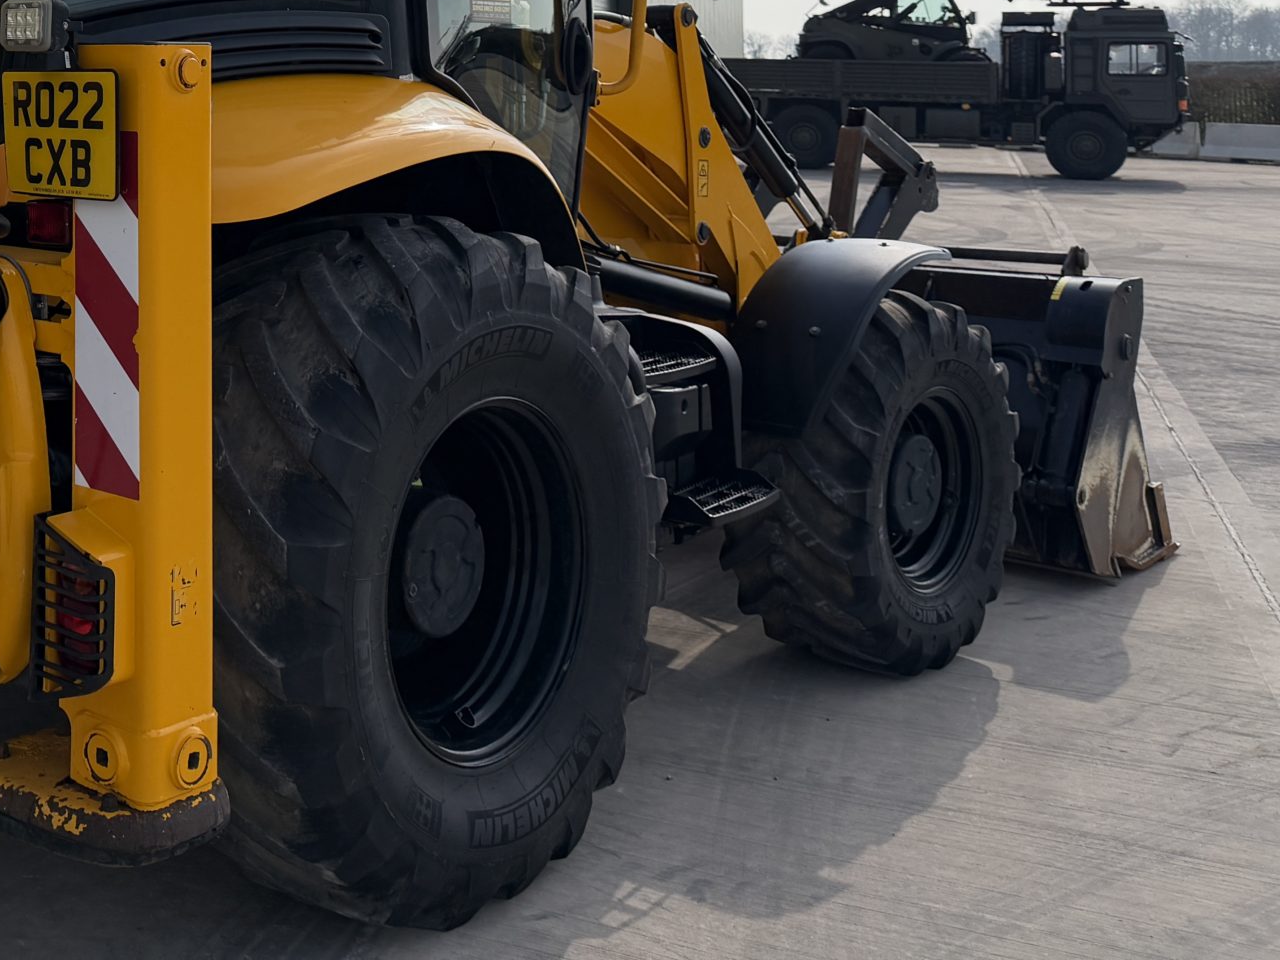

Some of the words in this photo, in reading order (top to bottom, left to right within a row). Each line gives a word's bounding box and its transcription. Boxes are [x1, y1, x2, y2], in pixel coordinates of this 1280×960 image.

[13, 80, 104, 130] RO22
[25, 137, 91, 187] CXB
[439, 327, 552, 392] MICHELIN
[472, 750, 580, 847] MICHELIN
